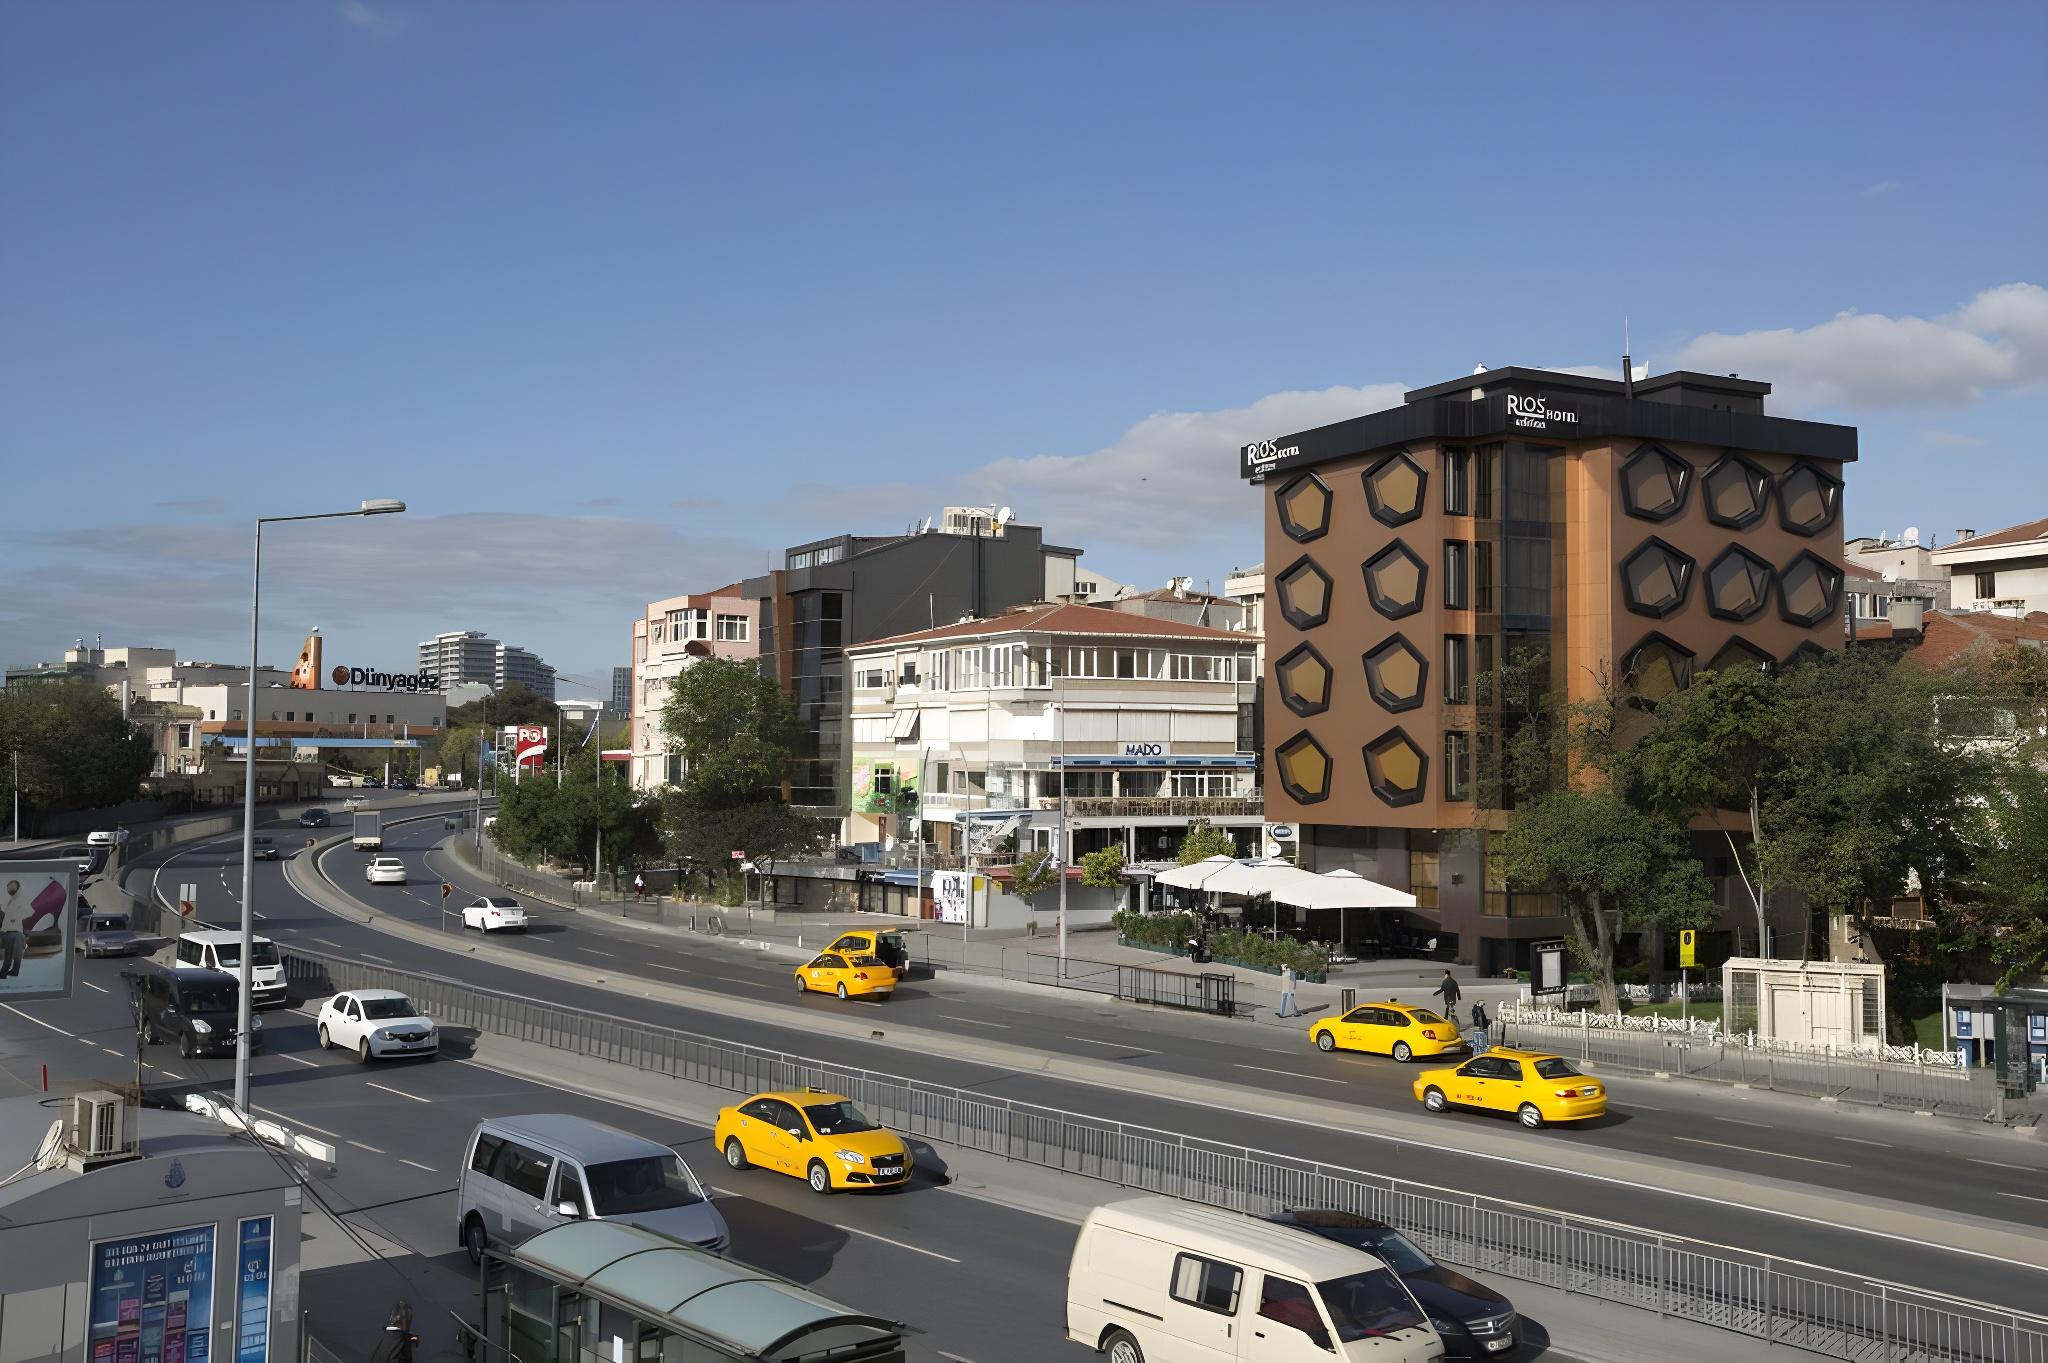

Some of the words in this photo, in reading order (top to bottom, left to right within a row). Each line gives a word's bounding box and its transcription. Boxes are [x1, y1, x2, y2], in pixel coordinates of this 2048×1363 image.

[1507, 393, 1546, 418] RIOS
[1247, 438, 1278, 466] RIOS
[350, 667, 439, 692] Dünyagöz
[1125, 742, 1162, 756] MADO
